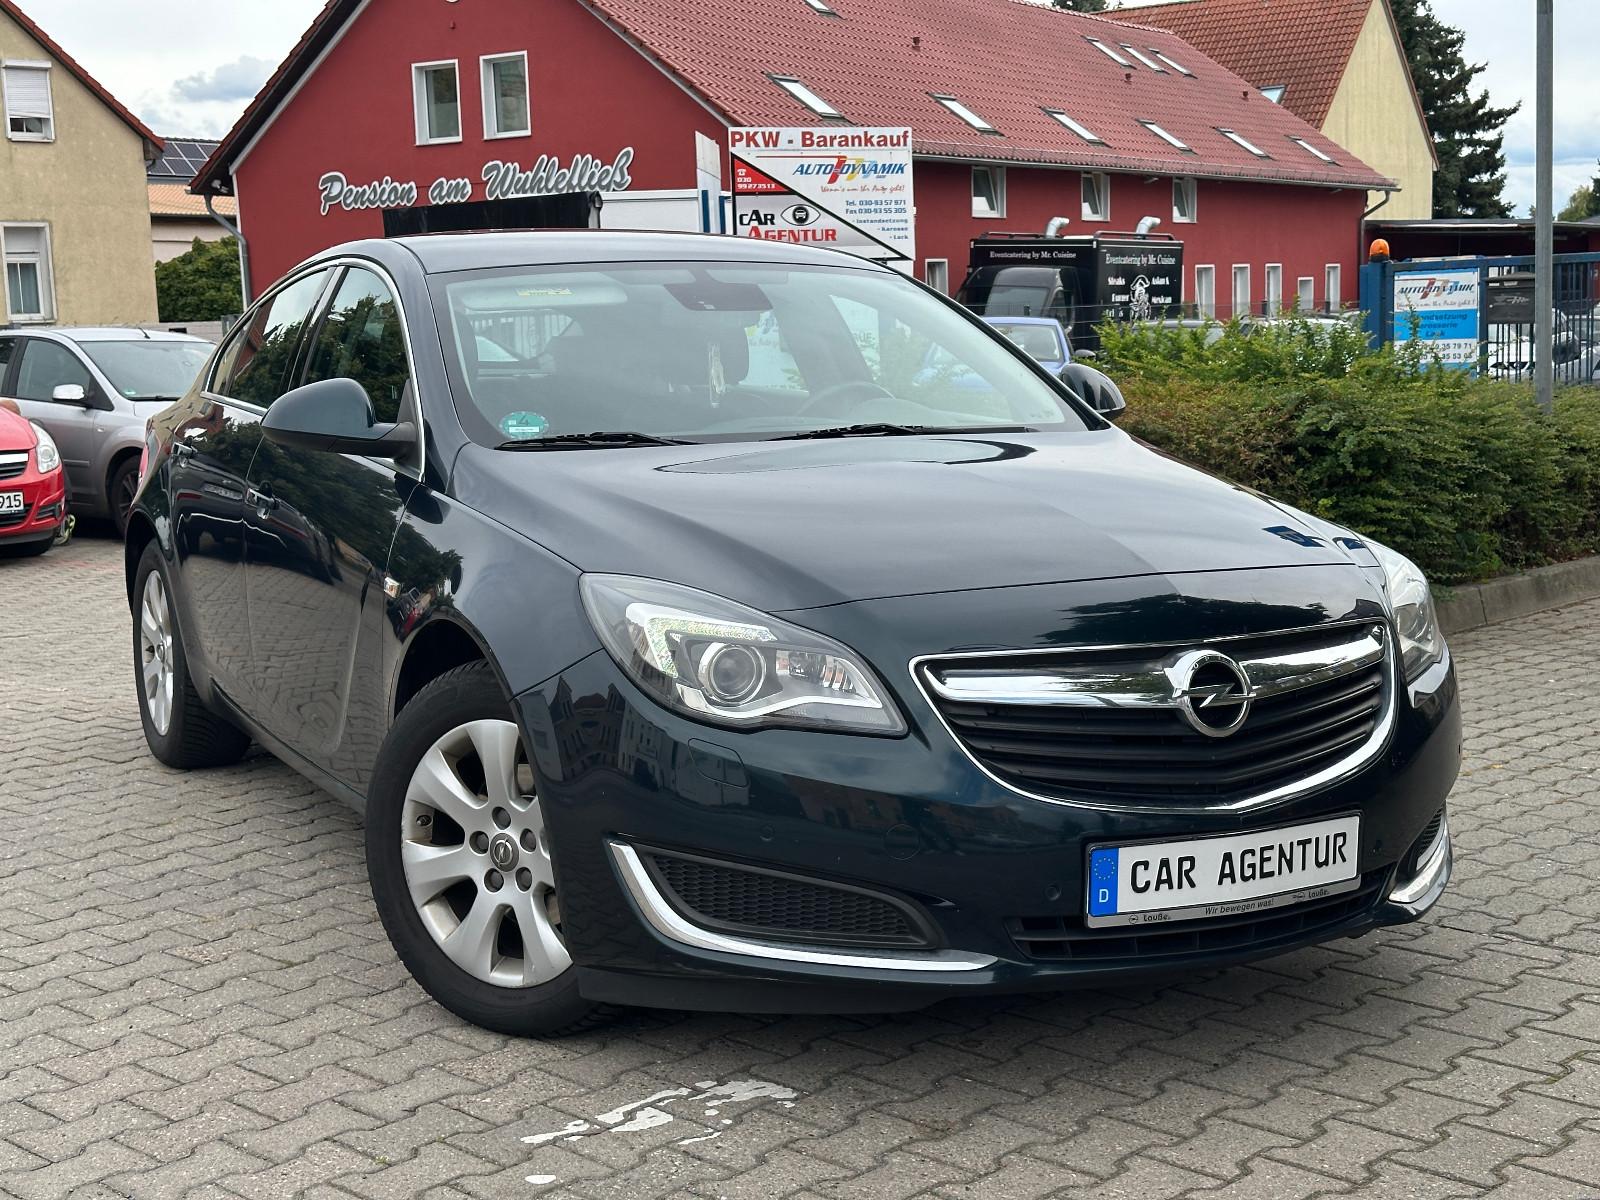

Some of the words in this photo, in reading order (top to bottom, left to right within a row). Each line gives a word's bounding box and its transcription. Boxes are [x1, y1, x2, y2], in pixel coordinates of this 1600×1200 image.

[730, 131, 780, 147] PKW
[801, 130, 909, 147] Barankauf
[319, 171, 417, 215] Pension
[429, 177, 472, 204] am
[482, 147, 634, 200] Wuhlefließ
[990, 251, 1031, 260] Eventcatering
[1032, 251, 1040, 260] by
[1105, 253, 1141, 267] Eventcatering
[1141, 254, 1147, 266] by
[1148, 254, 1157, 264] Mr.
[1157, 254, 1176, 265] Cuisine
[0, 494, 21, 508] 915
[1130, 855, 1196, 893] CAR
[1218, 831, 1347, 886] AGENTUR
[1099, 888, 1109, 903] D
[1205, 906, 1218, 915] Wir
[1220, 902, 1256, 914] bewegen
[1257, 898, 1274, 908] was!
